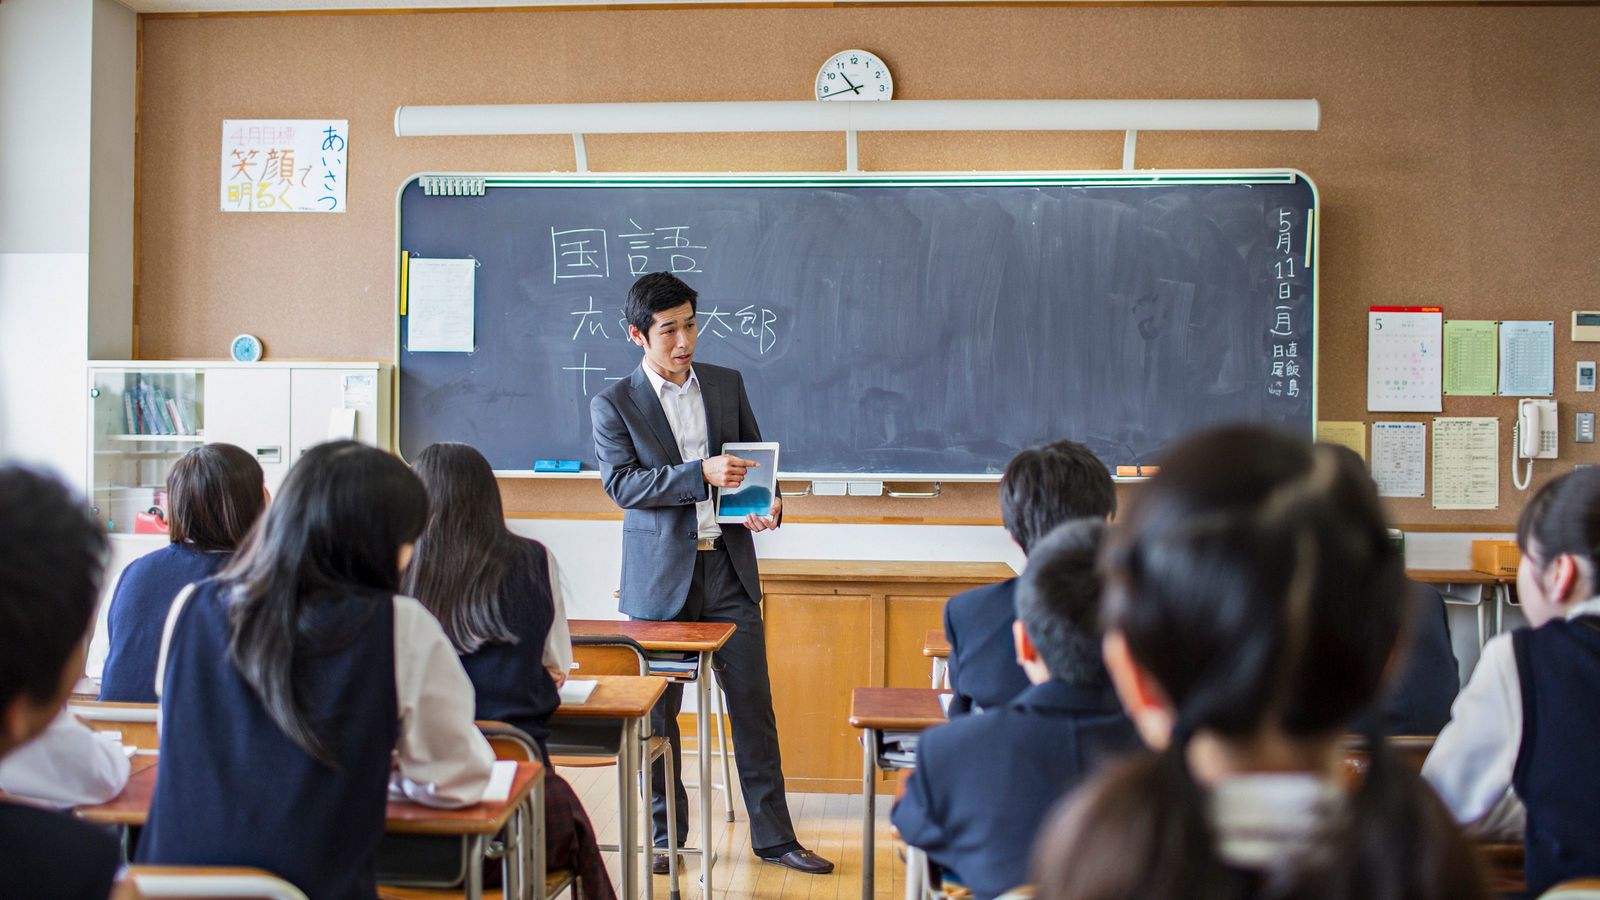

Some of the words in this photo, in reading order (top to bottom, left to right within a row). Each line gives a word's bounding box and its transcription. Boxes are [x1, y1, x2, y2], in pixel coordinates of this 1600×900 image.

[850, 57, 858, 65] 12
[827, 72, 836, 80] 10
[230, 148, 313, 188] 笑顔で
[317, 125, 345, 211] あいさつ
[227, 181, 294, 210] 明るく
[551, 218, 707, 285] 国語
[1375, 318, 1383, 331] 5
